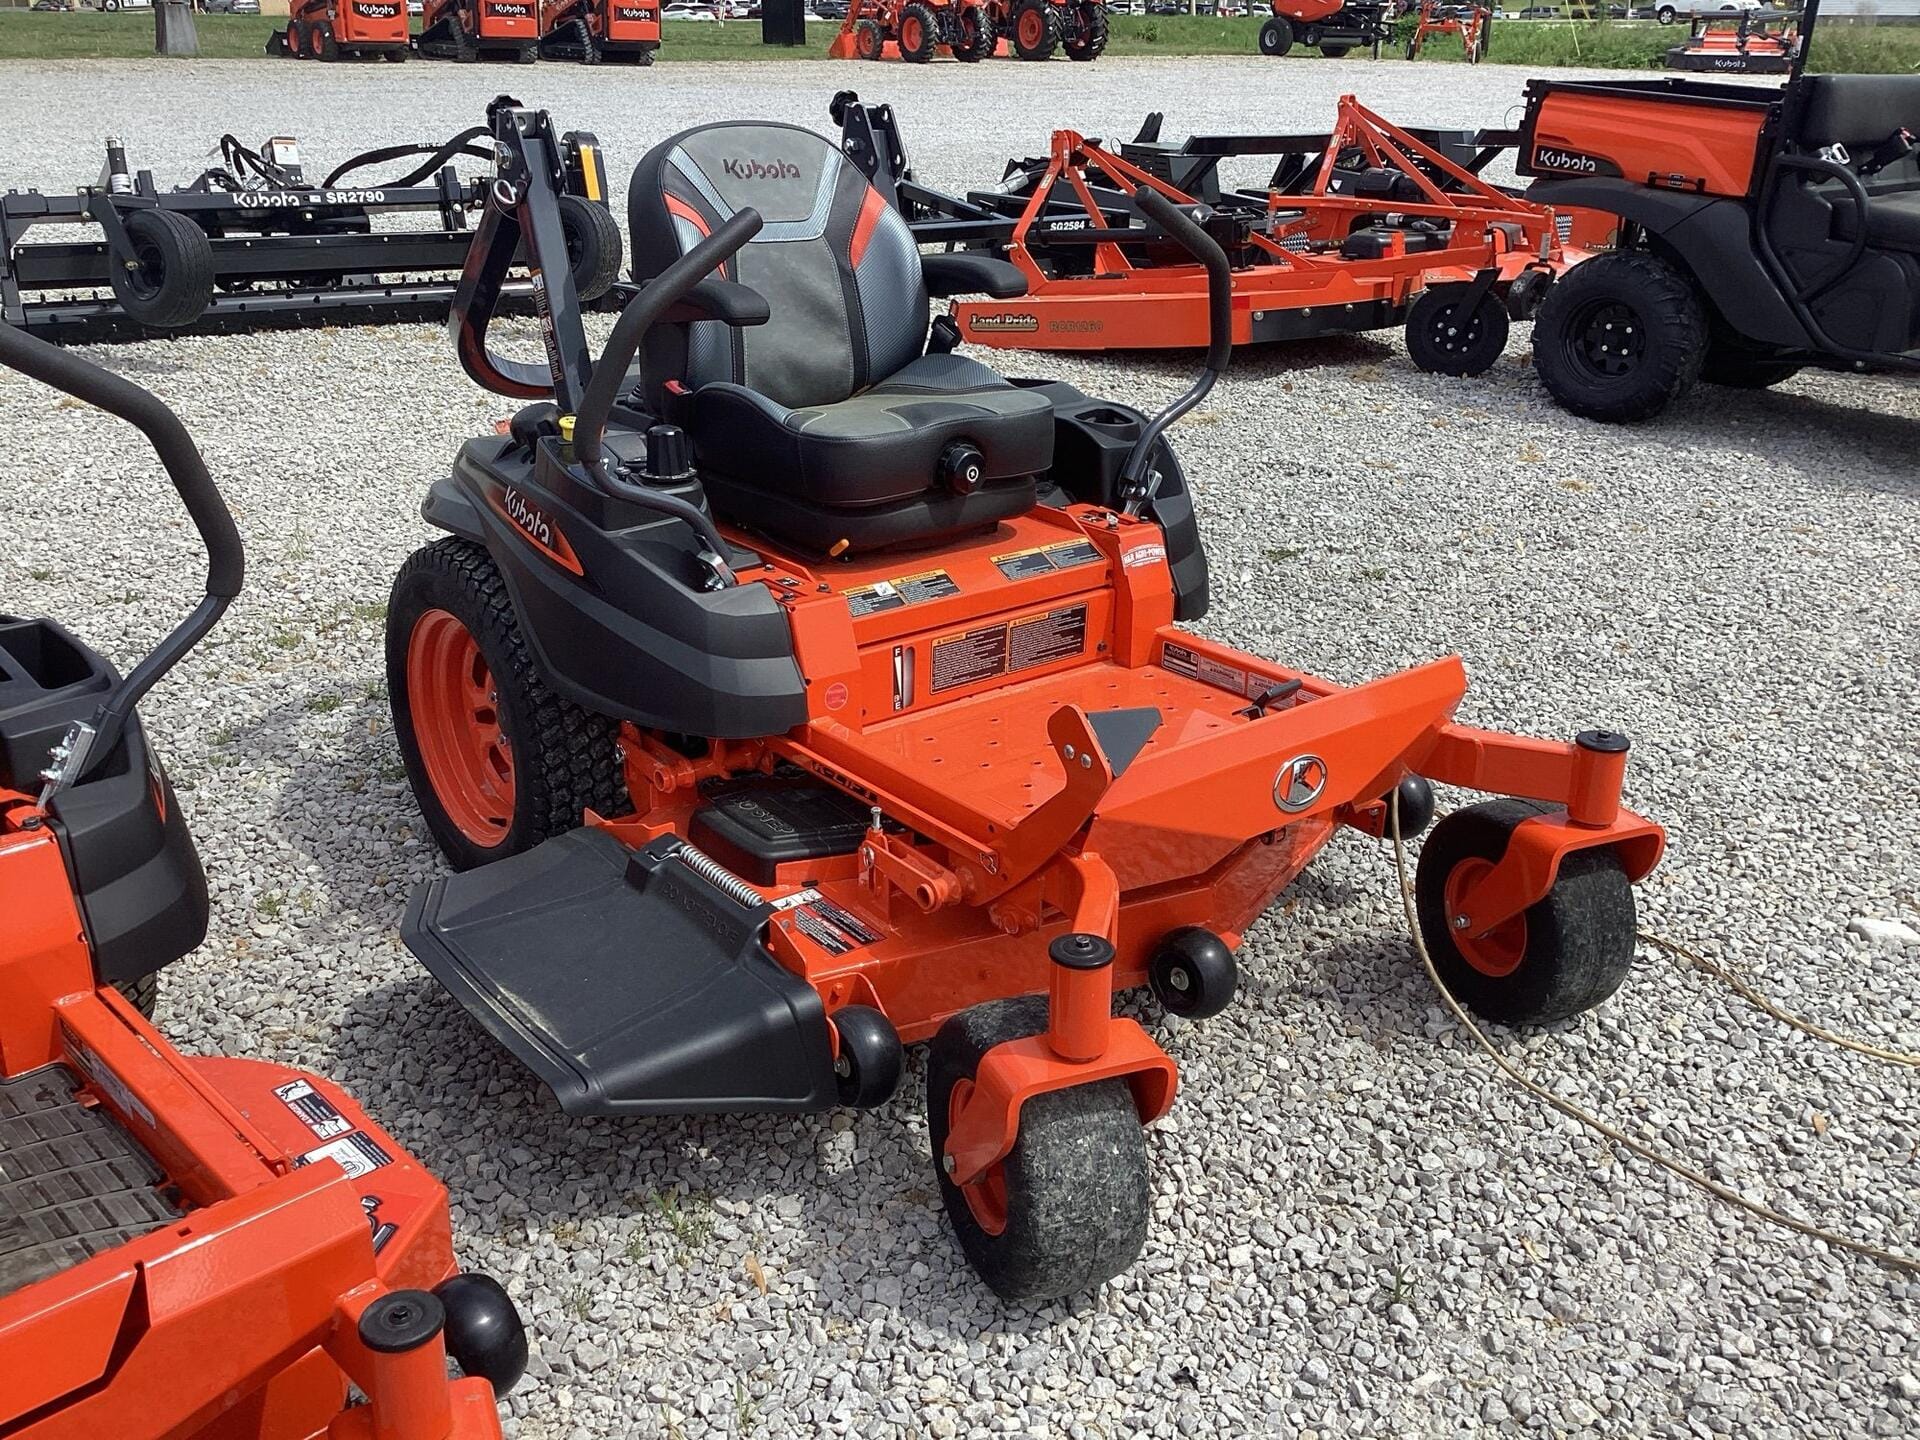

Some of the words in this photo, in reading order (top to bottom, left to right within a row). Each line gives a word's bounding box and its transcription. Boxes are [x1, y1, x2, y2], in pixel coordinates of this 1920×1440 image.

[359, 4, 396, 15] Kubota
[495, 4, 526, 14] Kubota
[623, 8, 650, 18] Kubota
[1714, 59, 1746, 68] Kubota
[1540, 150, 1596, 172] Kubota
[722, 158, 801, 179] Kubota
[232, 191, 300, 208] Kubota
[326, 190, 385, 204] SR2790
[1050, 220, 1086, 231] SG2584
[971, 314, 1001, 325] Land
[1004, 314, 1037, 325] Pride
[505, 485, 550, 545] Kubota
[895, 648, 901, 656] F
[895, 702, 901, 710] E
